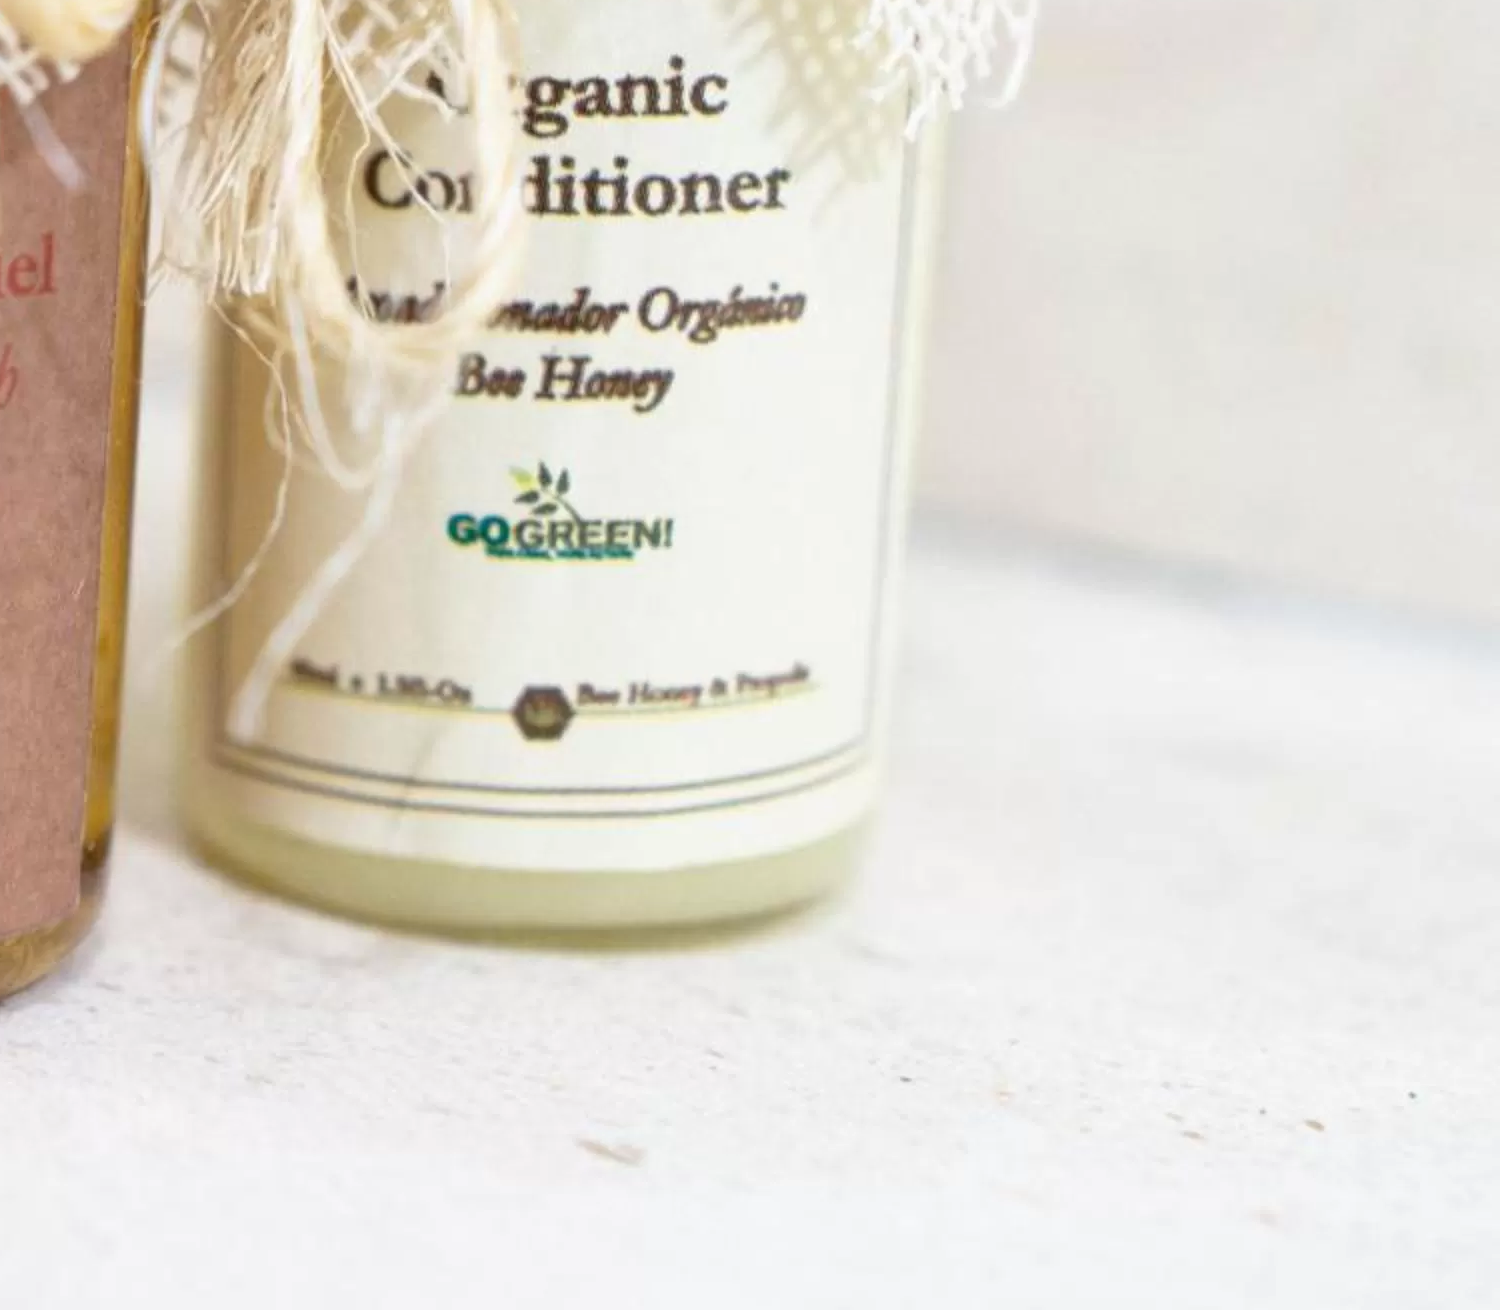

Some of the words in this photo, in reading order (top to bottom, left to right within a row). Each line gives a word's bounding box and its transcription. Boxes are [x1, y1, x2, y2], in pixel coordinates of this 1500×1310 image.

[427, 54, 728, 138] ganic
[638, 282, 807, 344] Orgánico
[455, 351, 526, 397] Bee
[534, 354, 675, 413] Honey
